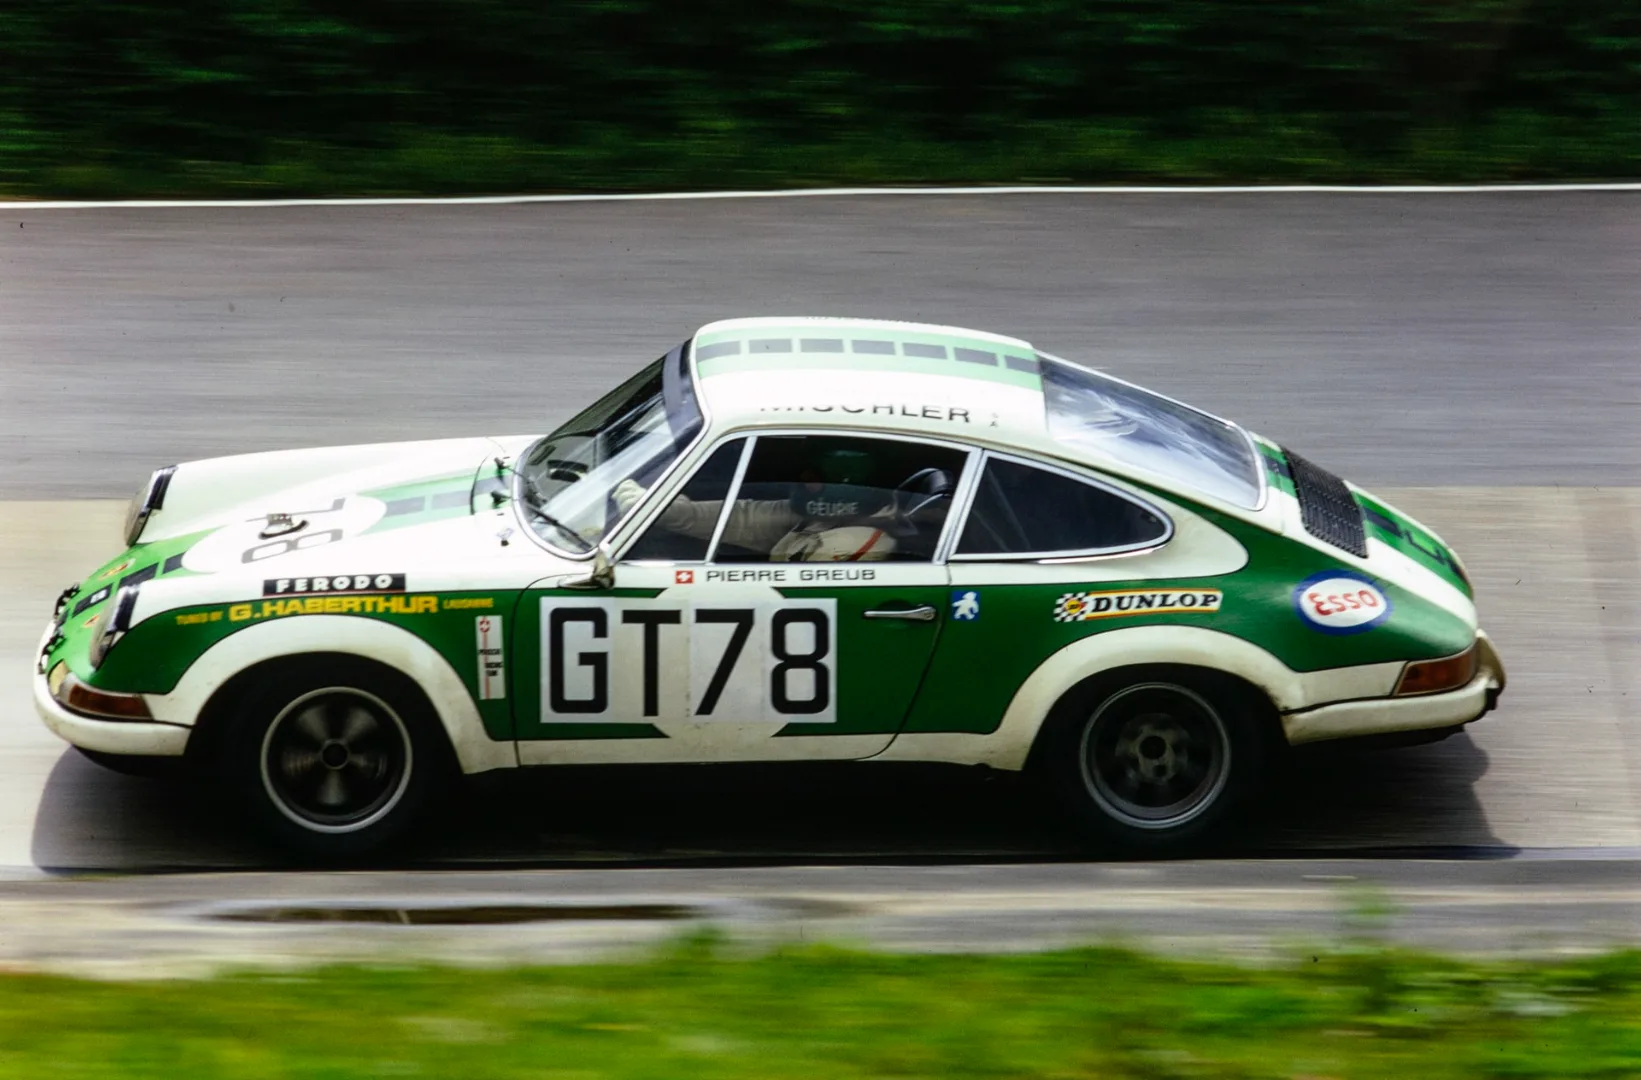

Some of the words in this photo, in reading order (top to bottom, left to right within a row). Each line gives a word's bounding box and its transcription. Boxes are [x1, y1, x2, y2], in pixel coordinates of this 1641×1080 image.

[276, 574, 393, 593] FERODO
[706, 570, 787, 582] PIERRE
[800, 569, 876, 581] GREUB
[229, 597, 438, 621] G.HABERTHUR
[1091, 593, 1219, 613] DUNLOP
[550, 607, 829, 717] GT78
